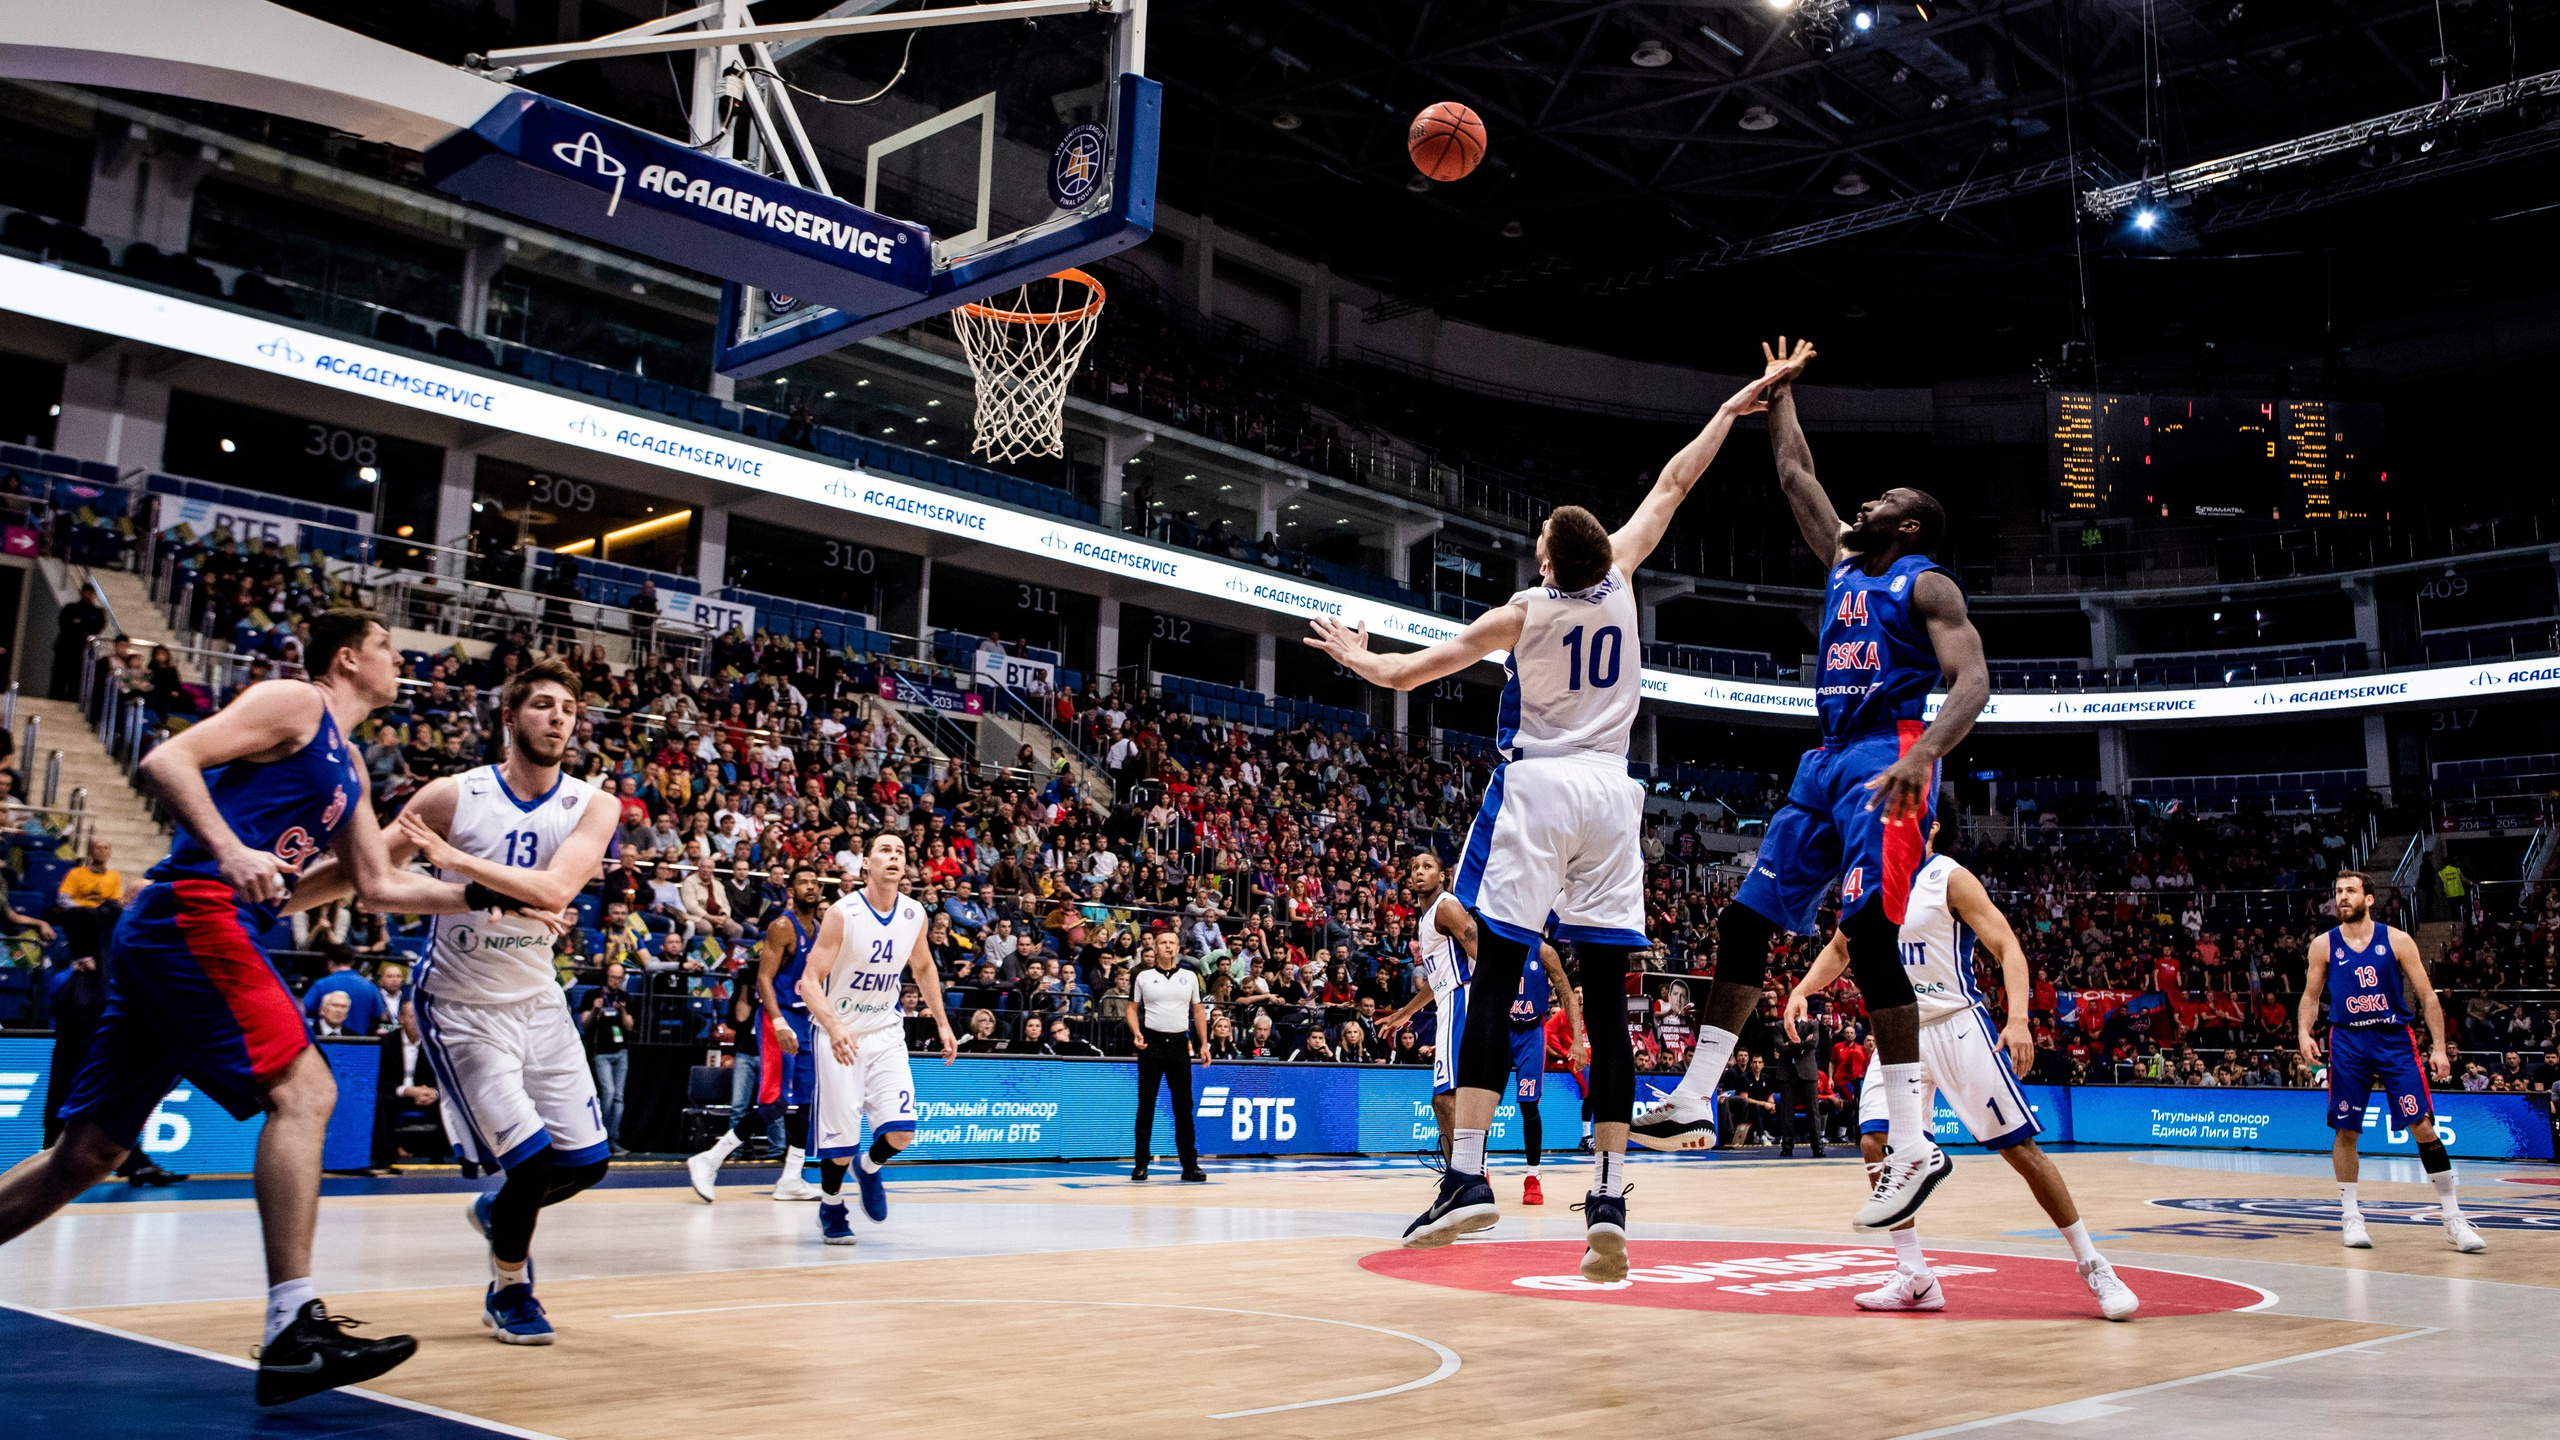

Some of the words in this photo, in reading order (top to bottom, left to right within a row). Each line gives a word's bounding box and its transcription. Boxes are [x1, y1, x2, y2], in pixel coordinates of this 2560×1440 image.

[1085, 124, 1104, 140] LEAGUE
[1060, 196, 1076, 206] FINAL
[1077, 185, 1093, 203] FOUR
[304, 425, 377, 467] 308
[532, 474, 596, 513] 309
[823, 541, 875, 575] 310
[2420, 577, 2469, 599] 409
[1018, 584, 1059, 616] 311
[1837, 590, 1868, 627] 44
[1152, 615, 1191, 645] 312
[1562, 625, 1622, 692] 10
[1827, 641, 1880, 671] CSKA
[932, 695, 952, 709] 203
[1434, 679, 1464, 702] 314
[2431, 708, 2479, 732] 317
[2459, 821, 2480, 831] 204
[2496, 819, 2517, 829] 205
[505, 830, 538, 868] 13
[870, 939, 893, 964] 24
[1898, 942, 1926, 965] NIT
[850, 970, 899, 992] ZENIT
[2355, 965, 2379, 988] 13
[1519, 1079, 1536, 1096] 21
[586, 1095, 601, 1132] 1
[917, 1098, 988, 1121] тульный
[991, 1102, 1058, 1121] спонсор
[1986, 1097, 2006, 1126] 1
[2151, 1108, 2215, 1124] Титульный
[2218, 1113, 2270, 1126] спонсор
[2399, 1095, 2419, 1118] 13
[1231, 1097, 1297, 1141] ВТБ
[1412, 1122, 1440, 1139] Един
[1946, 1121, 1959, 1134] ВТБ
[912, 1124, 961, 1146] диной
[964, 1124, 1004, 1143] Лиги
[1007, 1123, 1041, 1142] ВТБ
[2152, 1124, 2198, 1138] Единой
[2200, 1126, 2229, 1138] Лиги
[2232, 1126, 2258, 1139] ВТБ
